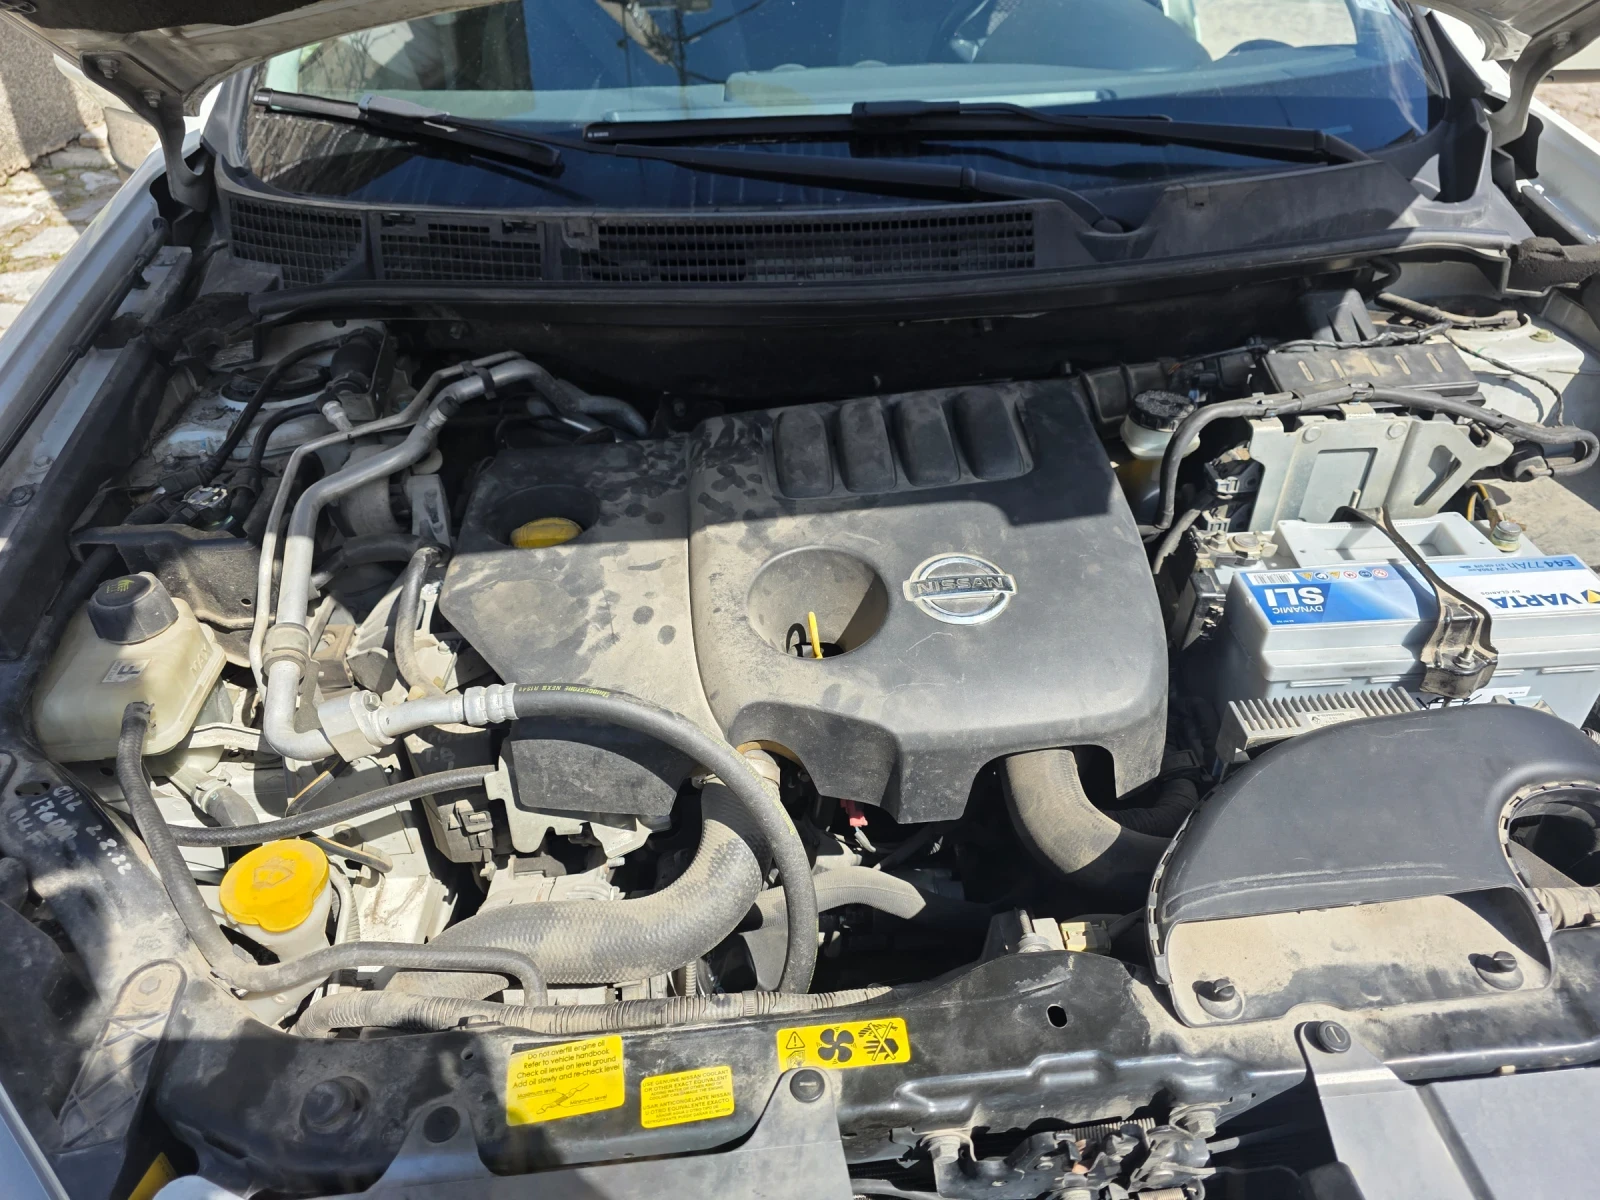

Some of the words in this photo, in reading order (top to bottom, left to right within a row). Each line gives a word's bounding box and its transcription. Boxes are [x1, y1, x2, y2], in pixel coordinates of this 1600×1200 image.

[1507, 561, 1545, 570] 77Ah
[1544, 559, 1576, 567] E44
[916, 576, 1005, 594] NISSAN
[1263, 586, 1325, 607] SLI
[1486, 593, 1583, 608] VARTA
[1271, 604, 1324, 615] DYNAMIC
[551, 1046, 572, 1056] overfill
[574, 1043, 596, 1052] engine
[524, 1061, 542, 1069] Refer
[550, 1055, 574, 1064] vehicle
[576, 1048, 610, 1060] handbook
[516, 1070, 539, 1079] Check
[540, 1067, 548, 1075] oil
[549, 1064, 564, 1074] level
[576, 1060, 592, 1069] level
[592, 1056, 616, 1066] ground
[512, 1080, 528, 1089] Add
[528, 1078, 536, 1086] oil
[538, 1074, 558, 1084] slowly
[558, 1072, 572, 1080] and
[574, 1066, 603, 1078] re-check
[604, 1063, 620, 1073] level
[655, 1076, 680, 1085] GENUINE
[702, 1070, 728, 1078] COOLANT
[674, 1080, 692, 1088] EXACT
[694, 1075, 728, 1084] EQUIVALENT
[517, 1090, 543, 1098] Maximum
[570, 1097, 594, 1105] Minimum
[660, 1095, 708, 1107] ANTICONGELANTE
[668, 1102, 706, 1112] EQUIVALENTE
[706, 1097, 730, 1106] EXACTO
